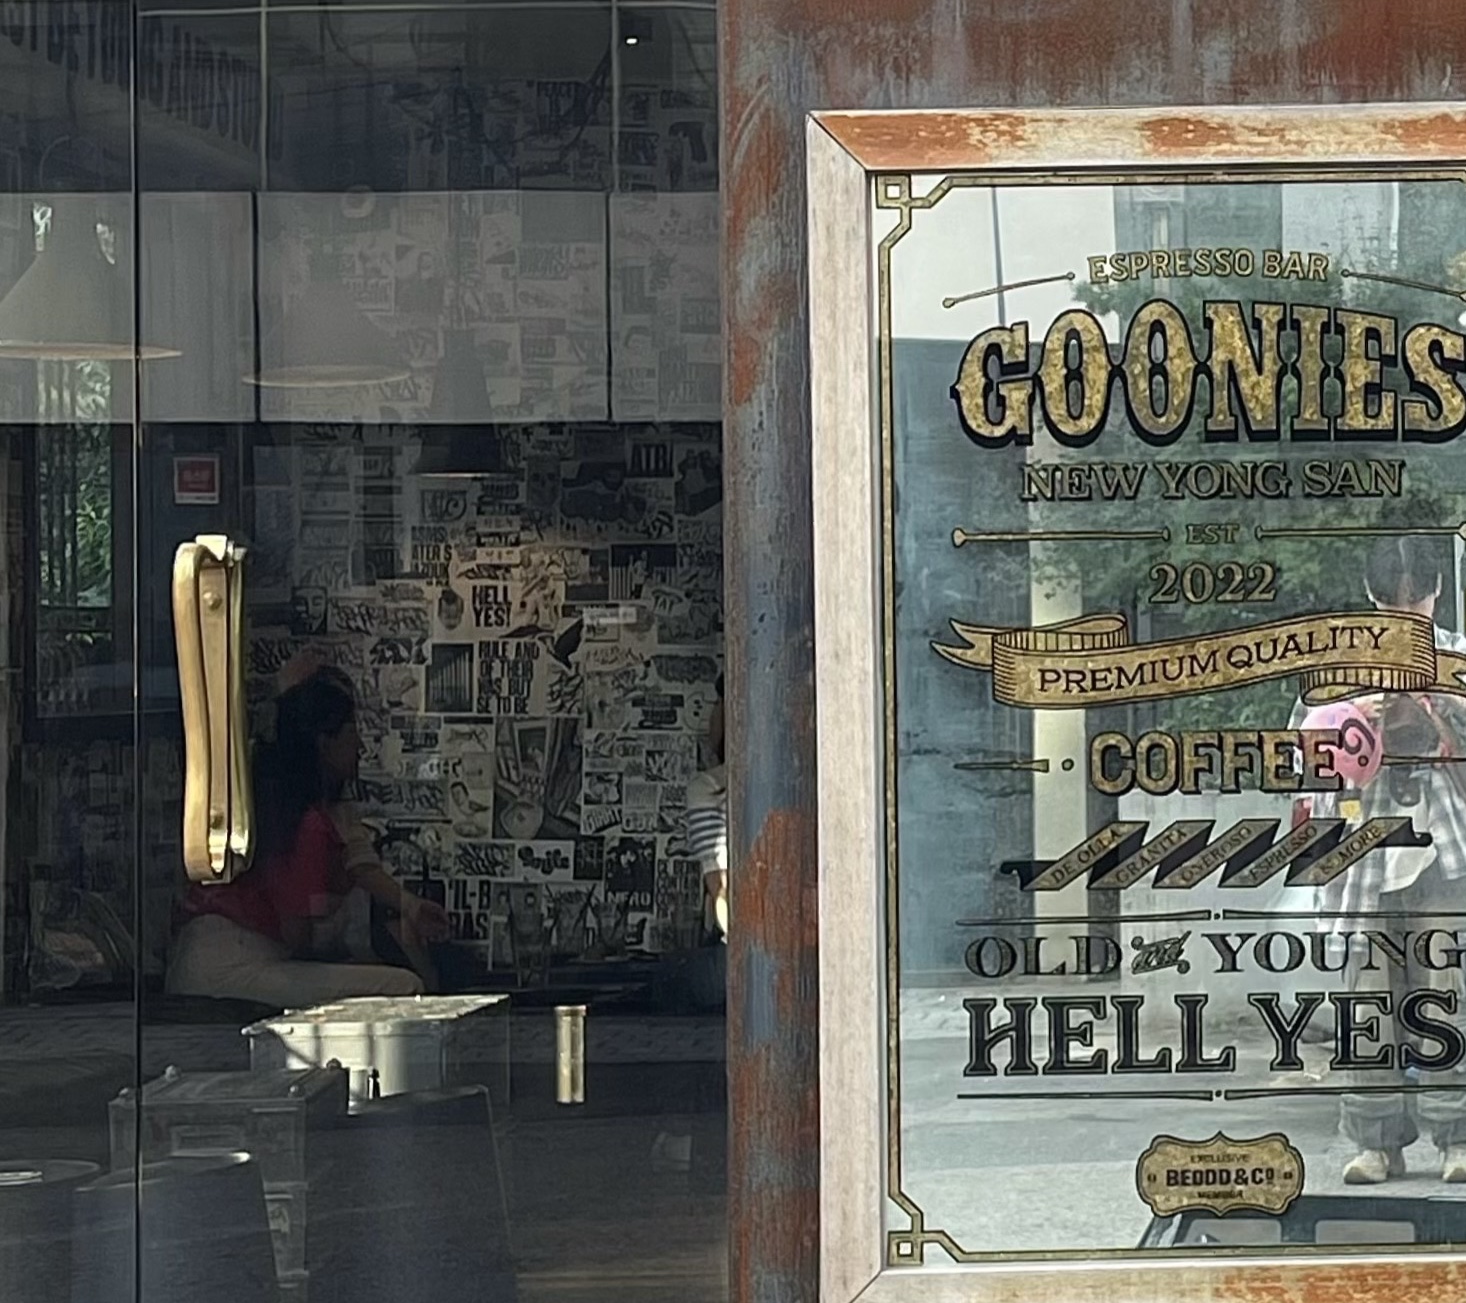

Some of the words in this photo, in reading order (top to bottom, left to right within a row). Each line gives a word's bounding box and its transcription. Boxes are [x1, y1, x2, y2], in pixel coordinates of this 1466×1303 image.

[1087, 248, 1254, 284] ESPRESSO
[1262, 249, 1330, 282] BAR
[1020, 463, 1147, 502] NEW
[1153, 461, 1293, 499] YONG
[1302, 459, 1406, 497] SAN
[1185, 523, 1240, 546] EST
[472, 585, 512, 605] HELL
[1149, 562, 1279, 604] 2022
[473, 605, 512, 627] YES!
[515, 640, 540, 660] AND
[1038, 649, 1219, 694] PREMIUM
[1226, 625, 1390, 670] QUALITY
[514, 697, 528, 714] BE
[1090, 729, 1344, 795] COFFEE
[1050, 862, 1076, 885] DE
[1076, 828, 1124, 865] OLLA
[1115, 827, 1188, 885] GRANITA
[1250, 825, 1319, 881] ESPRESSO
[1333, 824, 1388, 864] MORE
[964, 935, 1123, 979] OLD
[962, 993, 1237, 1078] HELL
[1247, 988, 1466, 1073] YES
